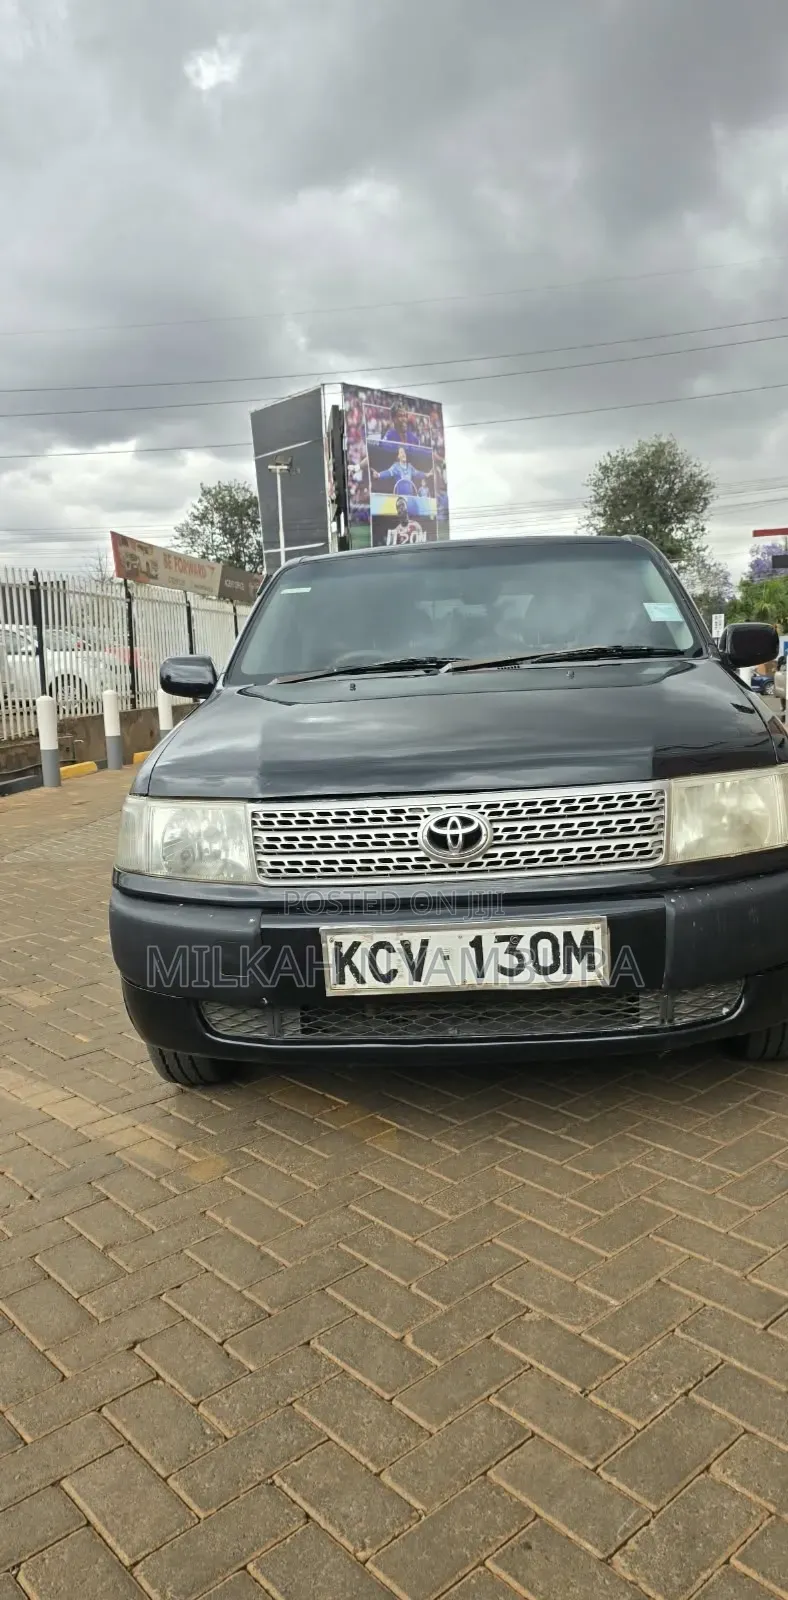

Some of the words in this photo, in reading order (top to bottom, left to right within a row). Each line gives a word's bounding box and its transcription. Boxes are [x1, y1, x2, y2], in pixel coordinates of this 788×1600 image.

[173, 555, 207, 579] FORWARD
[333, 938, 430, 985] KCV
[469, 930, 597, 979] 130M
